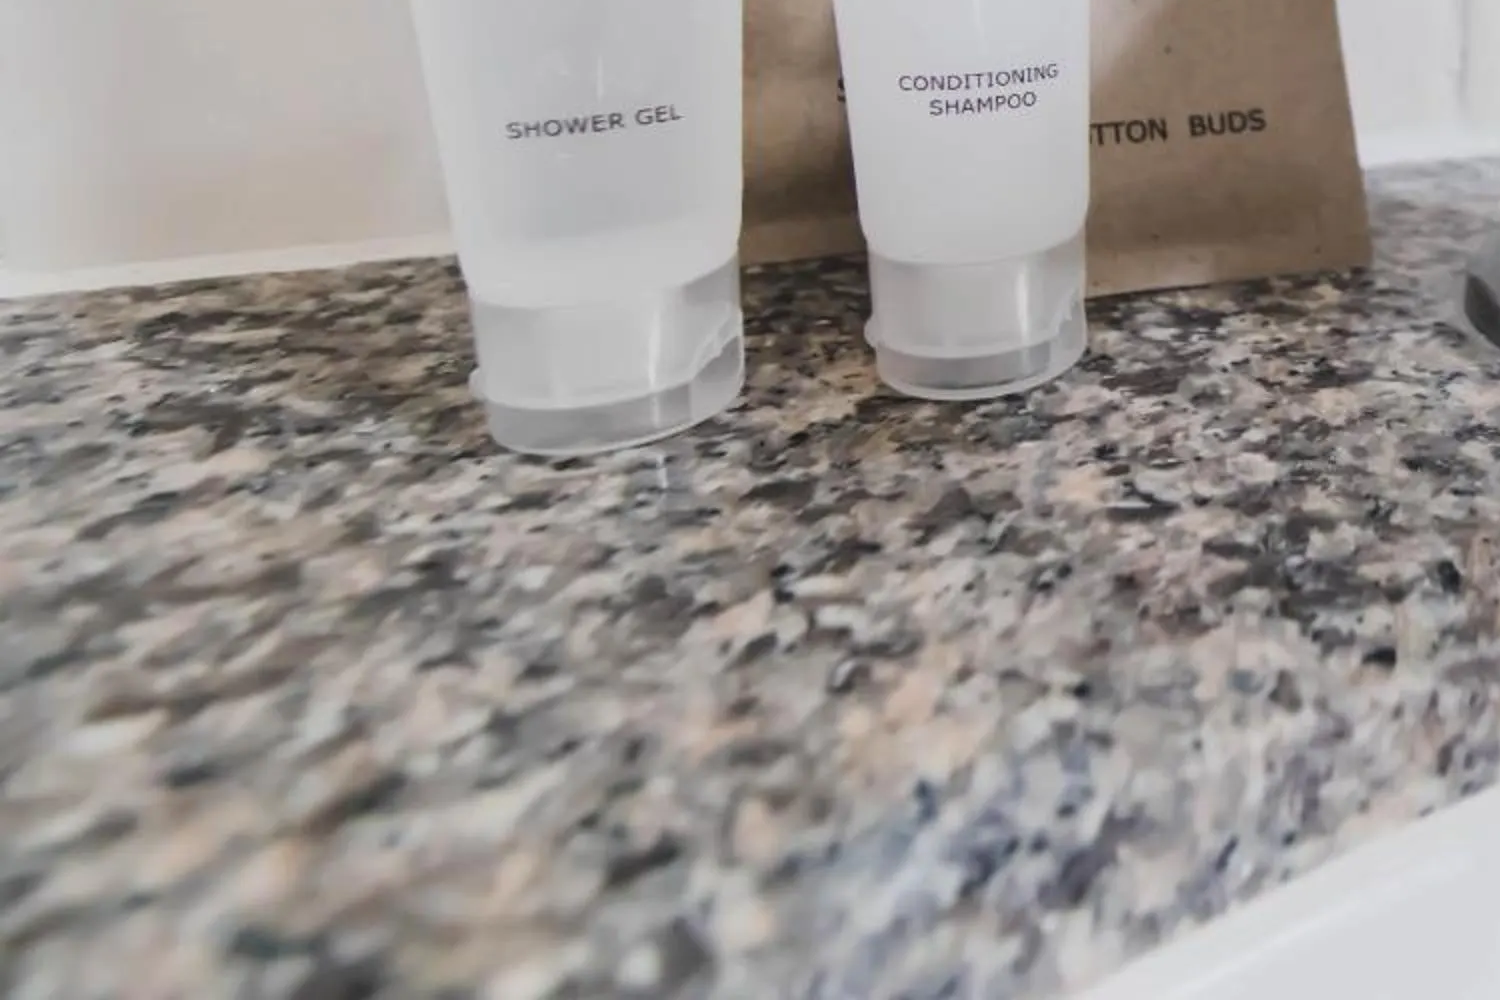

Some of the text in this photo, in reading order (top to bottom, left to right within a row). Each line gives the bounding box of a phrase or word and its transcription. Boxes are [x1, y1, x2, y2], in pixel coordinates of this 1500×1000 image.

[899, 63, 1059, 91] CONDITIONING
[929, 91, 1037, 116] SHAMPOO
[506, 103, 684, 140] SHOWER GEL
[1090, 108, 1267, 145] TTON BUDS
